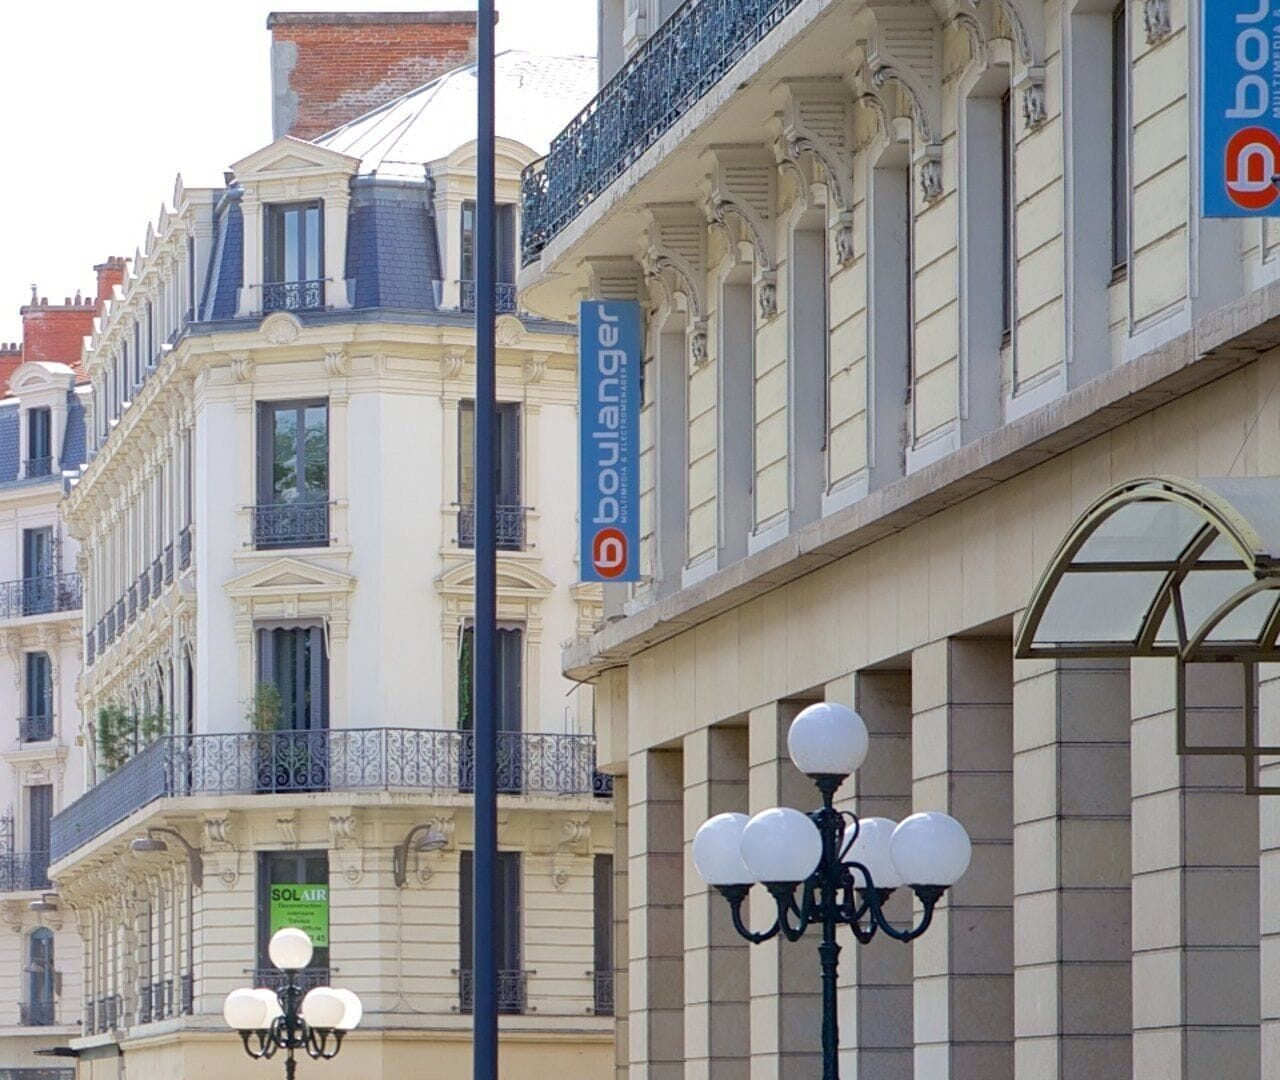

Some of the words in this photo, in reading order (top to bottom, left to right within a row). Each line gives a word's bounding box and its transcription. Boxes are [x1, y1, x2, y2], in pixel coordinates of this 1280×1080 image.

[592, 304, 628, 524] boulanger
[620, 466, 628, 524] MULTIMEDIA
[271, 888, 326, 901] SOLAIR
